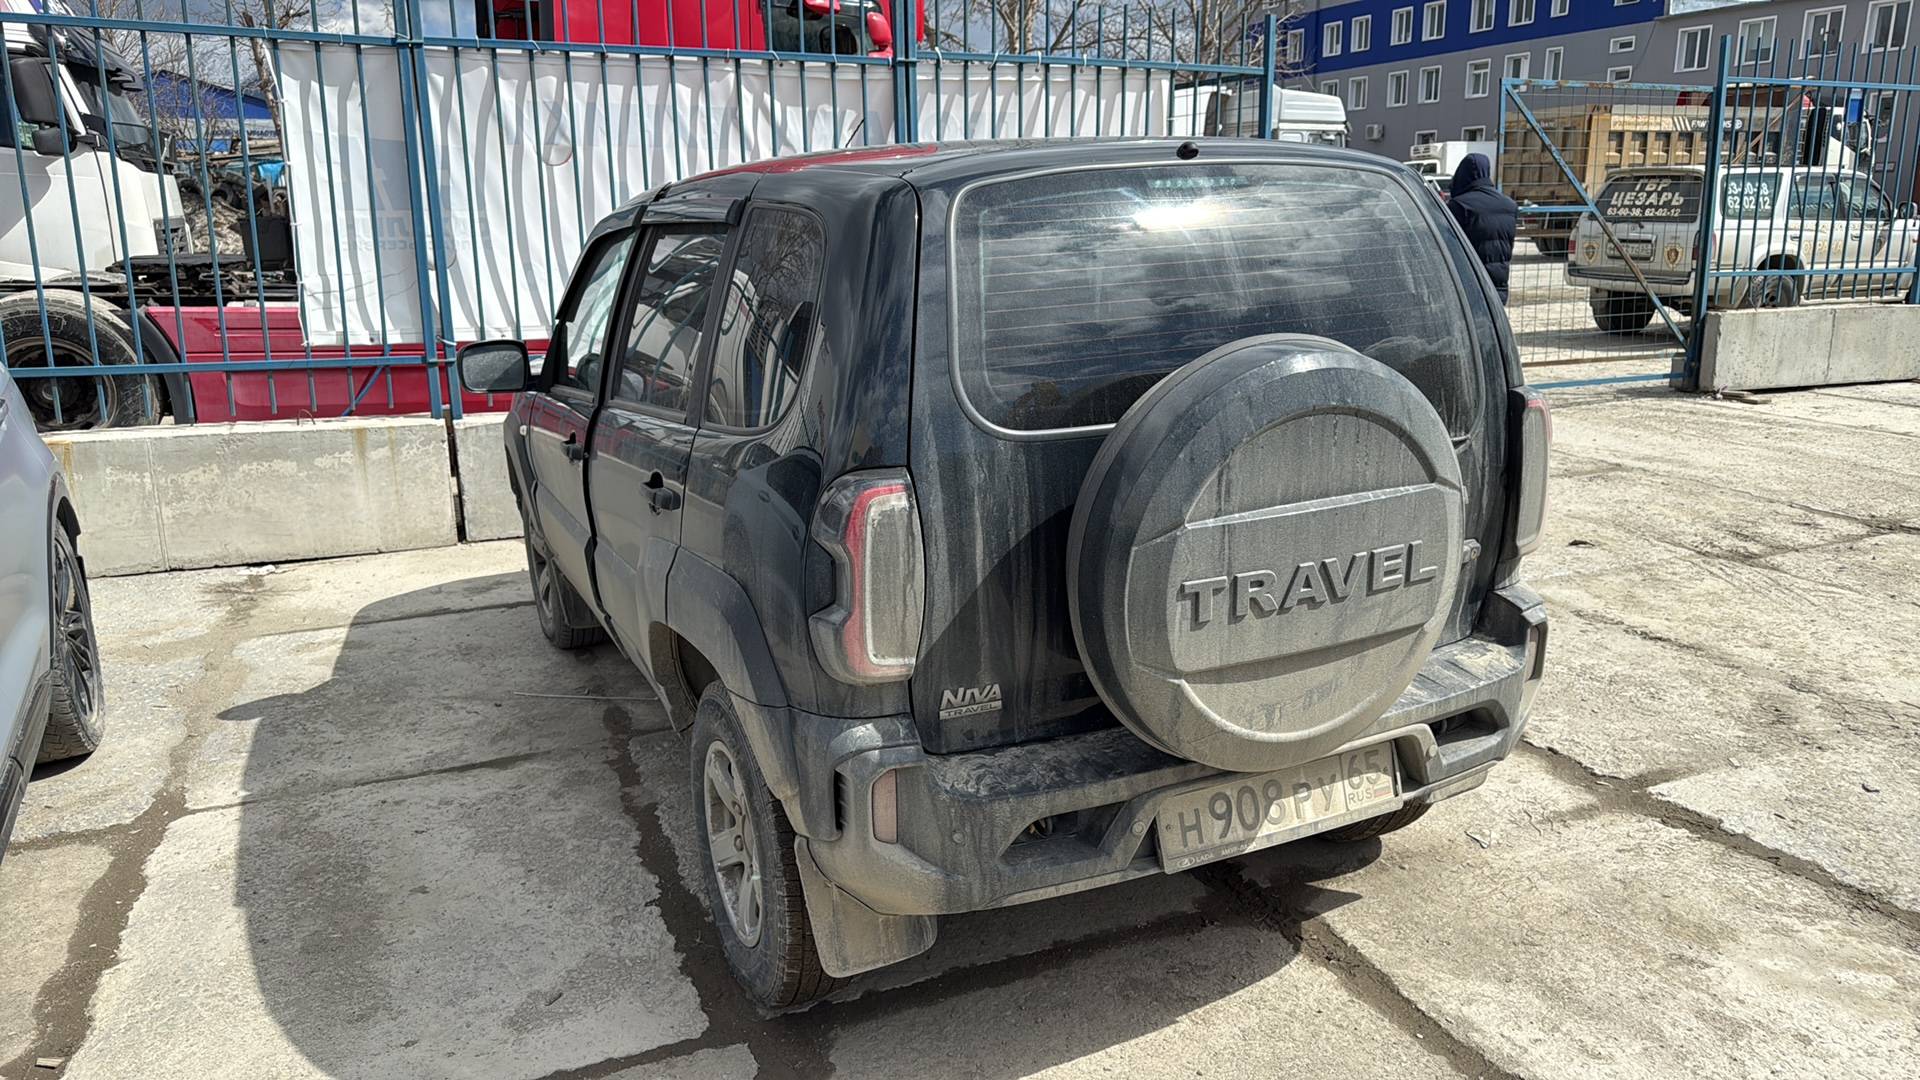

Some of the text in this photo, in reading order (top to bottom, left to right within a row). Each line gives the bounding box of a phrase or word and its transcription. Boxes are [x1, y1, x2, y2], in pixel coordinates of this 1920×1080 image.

[1634, 179, 1672, 192] ГБР
[1610, 191, 1684, 207] ЦЕЗАРЬ
[1177, 540, 1438, 632] TRAVEL
[940, 684, 1003, 710] NIVA
[944, 703, 998, 717] TRAVEL
[1348, 749, 1381, 790] 65
[1348, 788, 1373, 804] RUS
